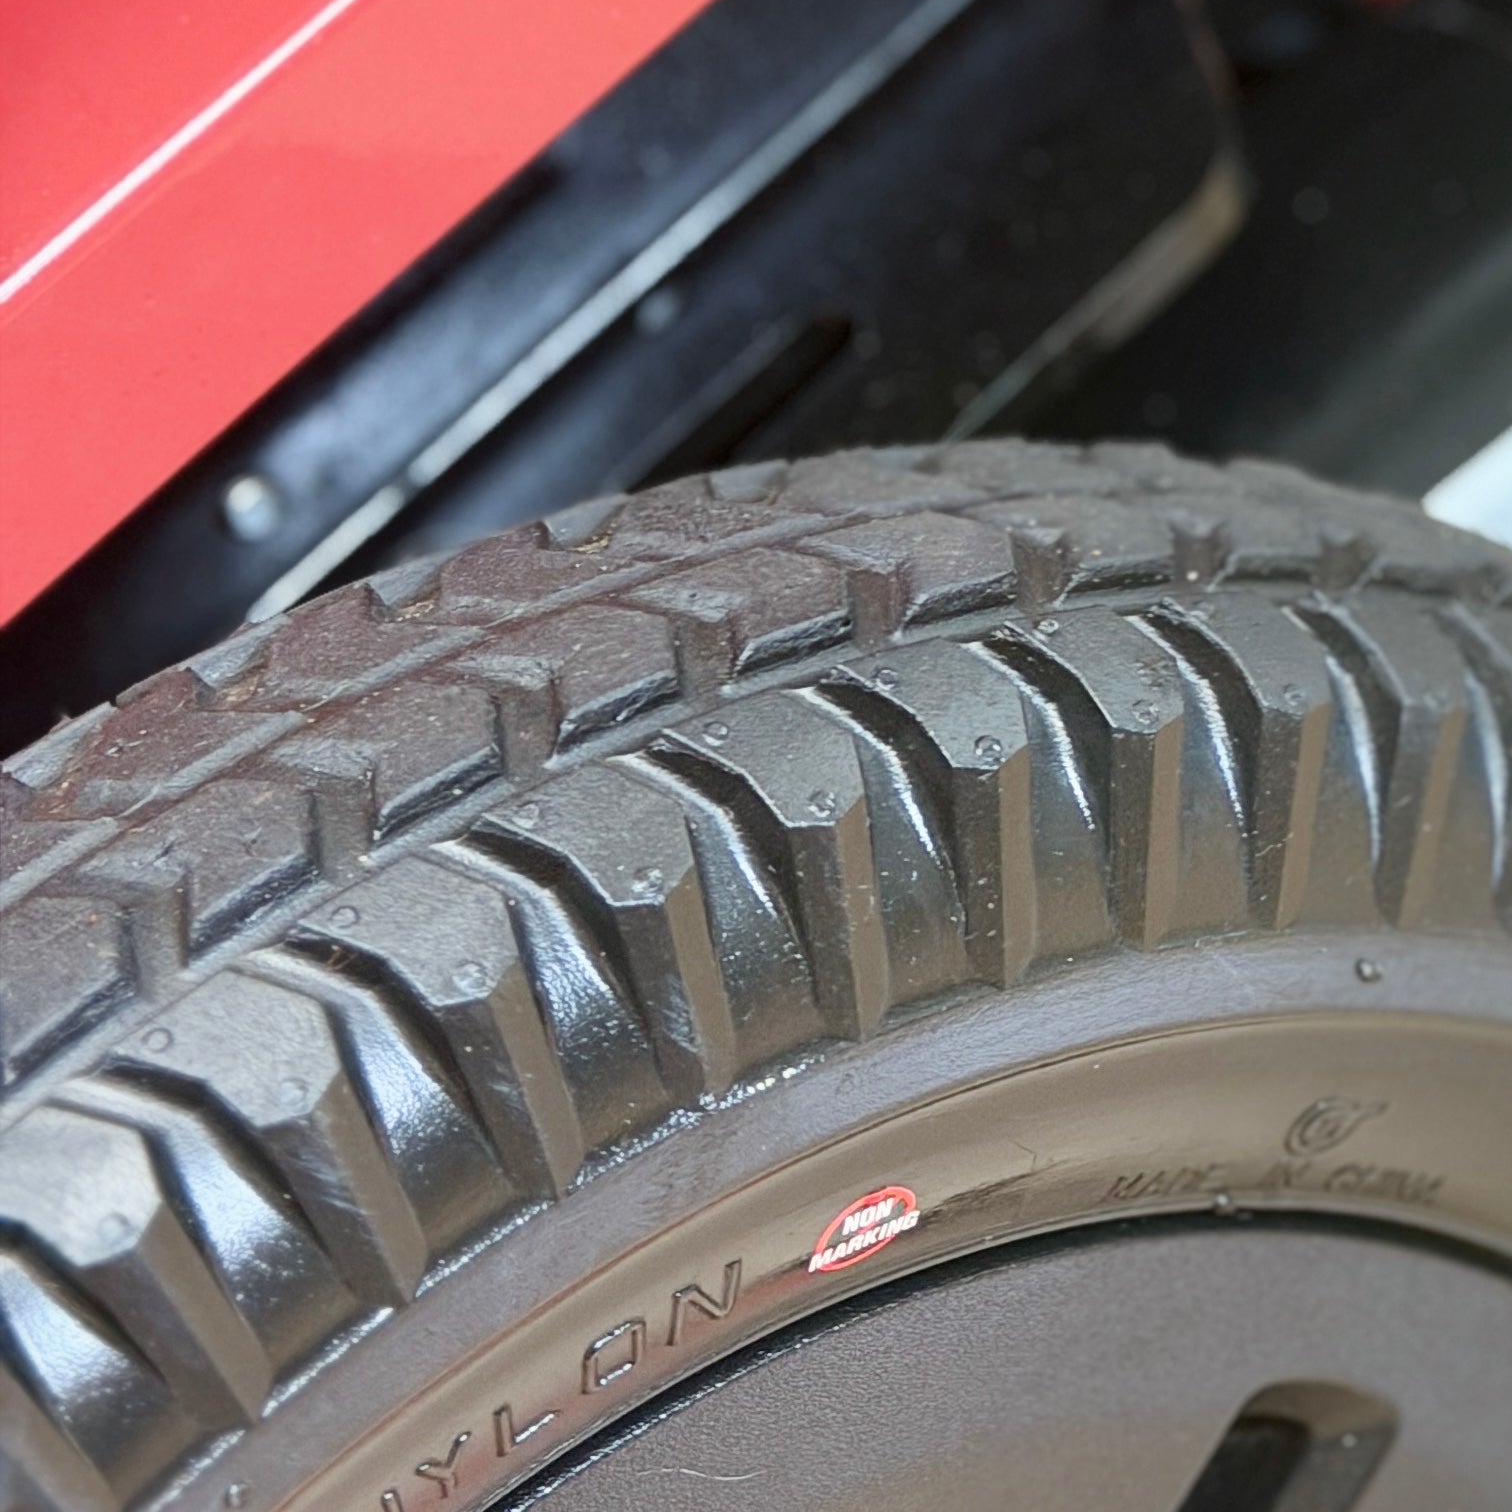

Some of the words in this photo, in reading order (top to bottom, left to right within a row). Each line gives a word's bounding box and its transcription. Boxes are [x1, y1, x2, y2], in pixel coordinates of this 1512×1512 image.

[808, 1210, 920, 1273] MARKING
[842, 1197, 895, 1236] NON
[380, 1256, 742, 1512] YLON
